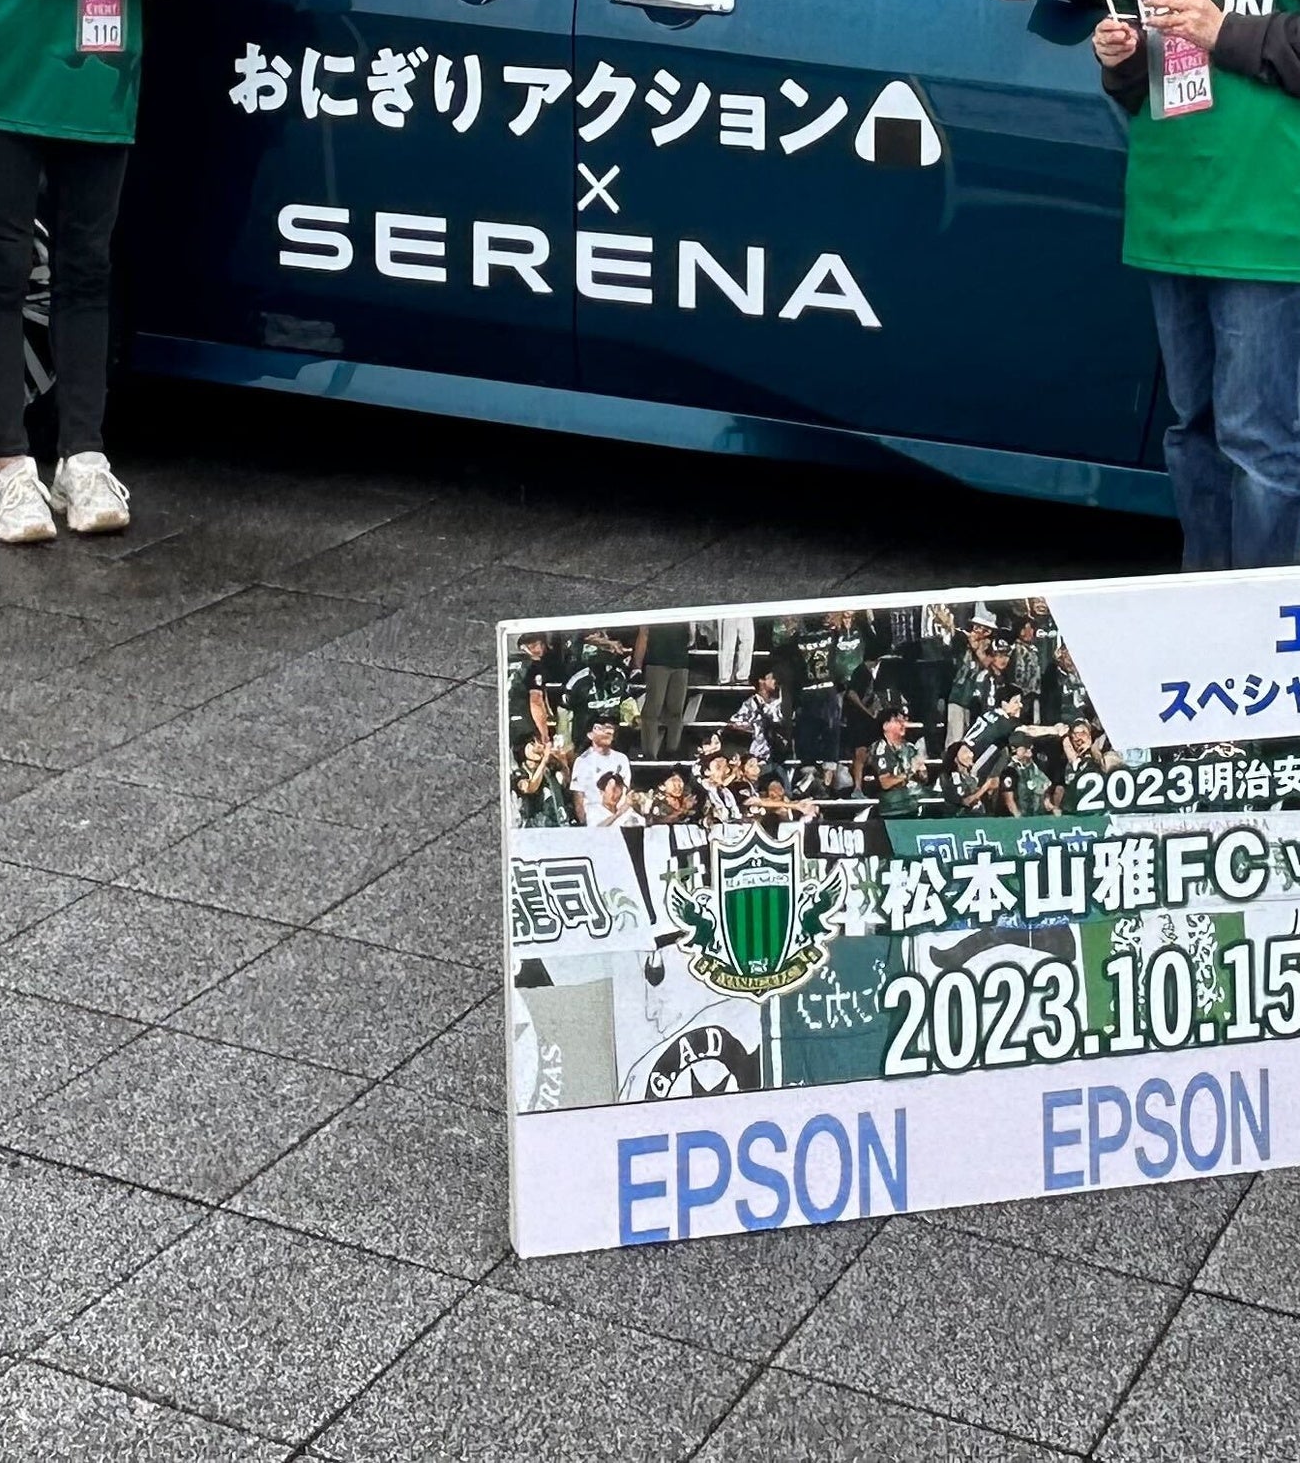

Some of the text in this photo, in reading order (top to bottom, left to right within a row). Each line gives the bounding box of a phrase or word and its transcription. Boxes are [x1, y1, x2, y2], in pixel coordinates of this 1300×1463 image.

[94, 24, 118, 44] 110
[1177, 78, 1207, 103] 104
[228, 42, 849, 155] おにぎりアクション
[277, 204, 882, 328] SERENA
[882, 830, 1267, 930] 松本山雅FC
[617, 1108, 908, 1246] EPSON
[1043, 1068, 1270, 1193] EPSON
